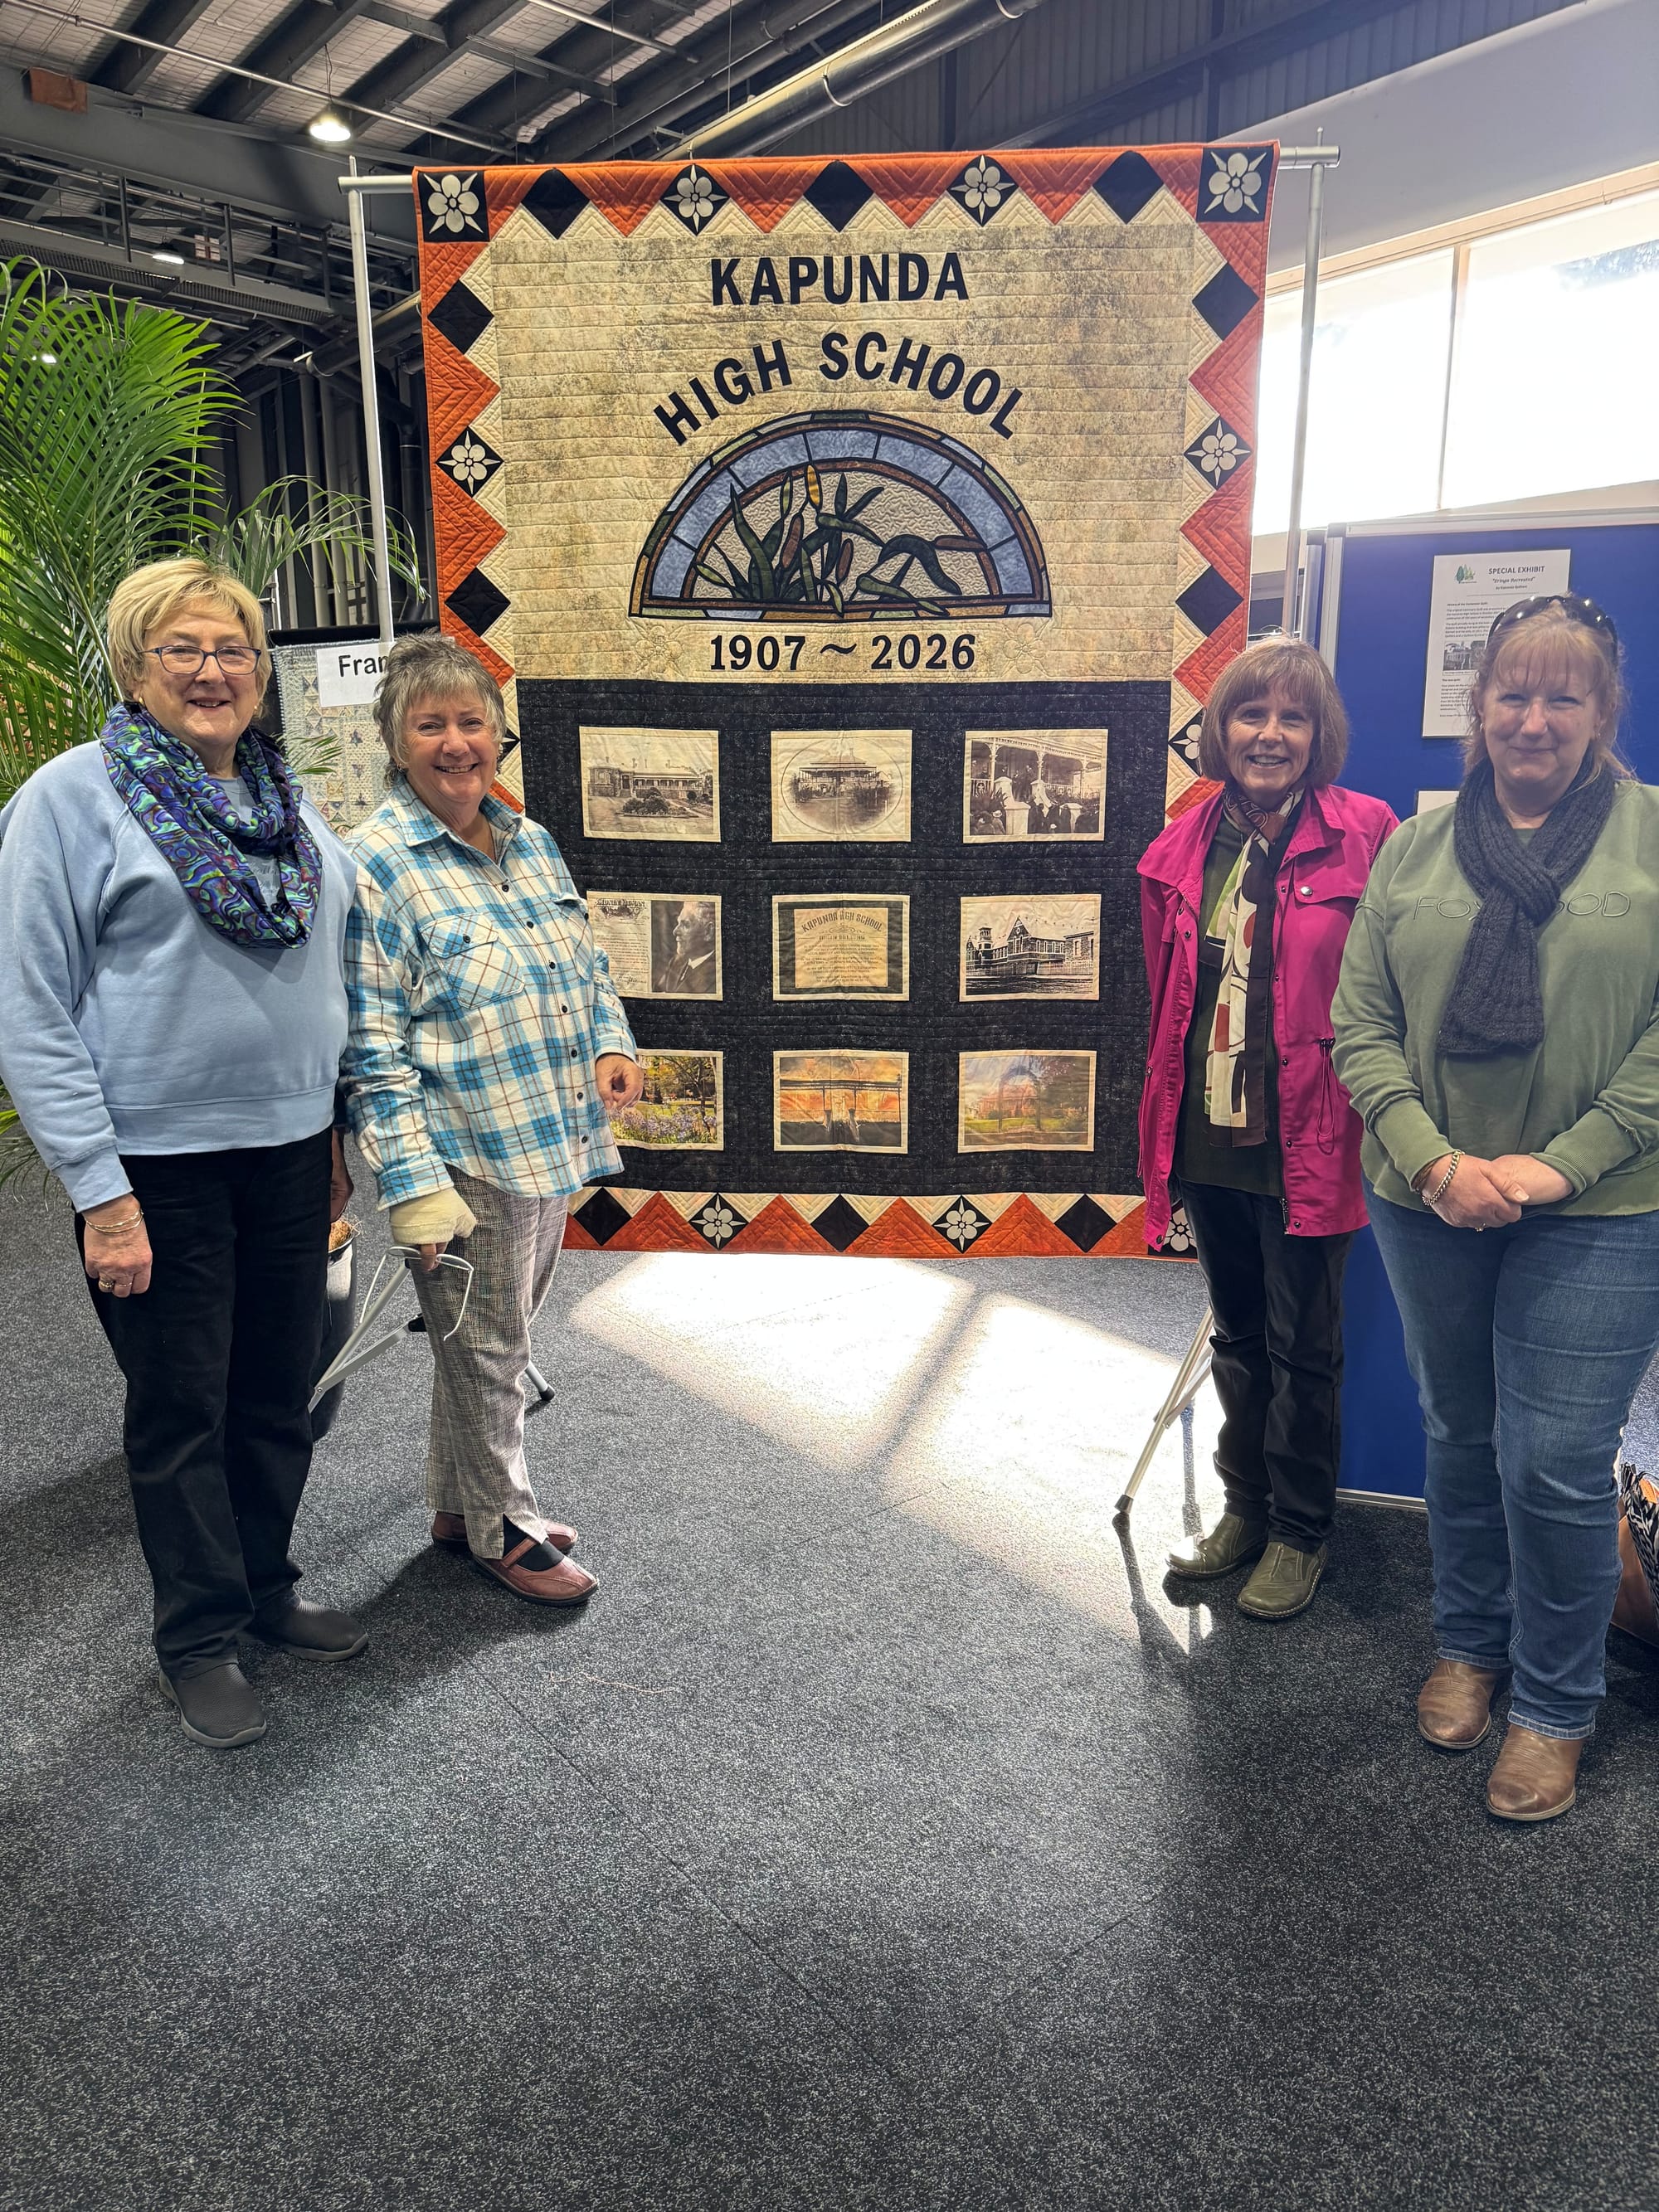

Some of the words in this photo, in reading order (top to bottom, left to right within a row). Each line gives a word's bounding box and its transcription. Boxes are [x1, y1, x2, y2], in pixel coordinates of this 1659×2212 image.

[711, 252, 969, 306] KAPUNDA
[653, 339, 793, 446] HIGH
[819, 332, 1024, 440] SCHOOL
[1488, 566, 1516, 575] SPECIAL
[1517, 566, 1545, 574] EXHIBIT
[710, 634, 806, 671] 1907
[870, 633, 976, 670] 2026
[801, 912, 838, 933] KAPUNDA
[856, 913, 883, 932] SCHOOL
